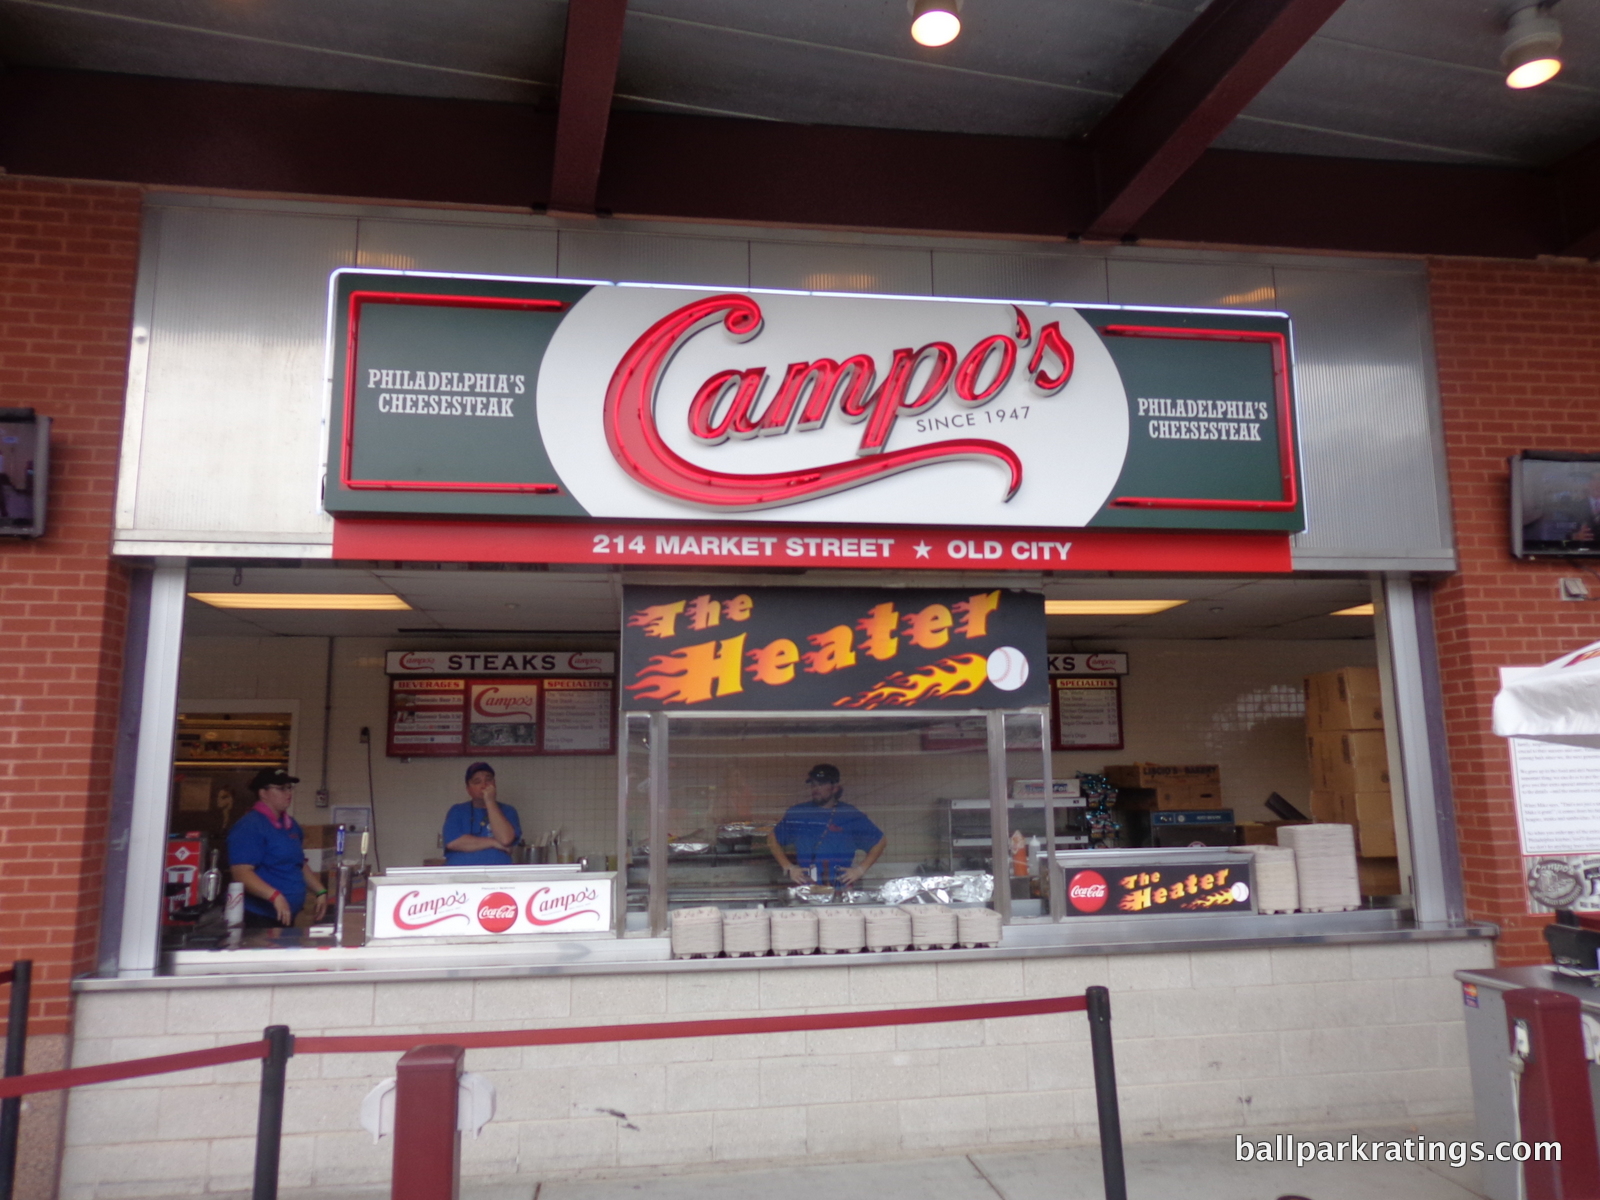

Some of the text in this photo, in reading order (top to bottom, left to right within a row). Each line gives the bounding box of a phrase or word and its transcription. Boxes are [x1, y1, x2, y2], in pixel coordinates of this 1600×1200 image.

[367, 369, 526, 395] PHILADELPHIA'S
[378, 393, 514, 418] CHEESESTEAK
[603, 293, 1075, 513] Campo's
[1137, 397, 1269, 421] PHILADELPHIA'S
[916, 405, 1030, 433] SINCE 1947
[1148, 419, 1262, 442] CHEESESTEAK
[592, 534, 895, 558] 214 MARKET STREET
[947, 539, 1072, 561] OLD CITY
[627, 593, 753, 638] The
[625, 589, 1001, 704] Heater
[447, 654, 556, 671] STEAKS
[473, 686, 534, 722] Campo's
[1116, 868, 1230, 911] Heater
[1118, 872, 1161, 890] The
[392, 890, 471, 930] Campo's
[525, 886, 600, 926] Campo's
